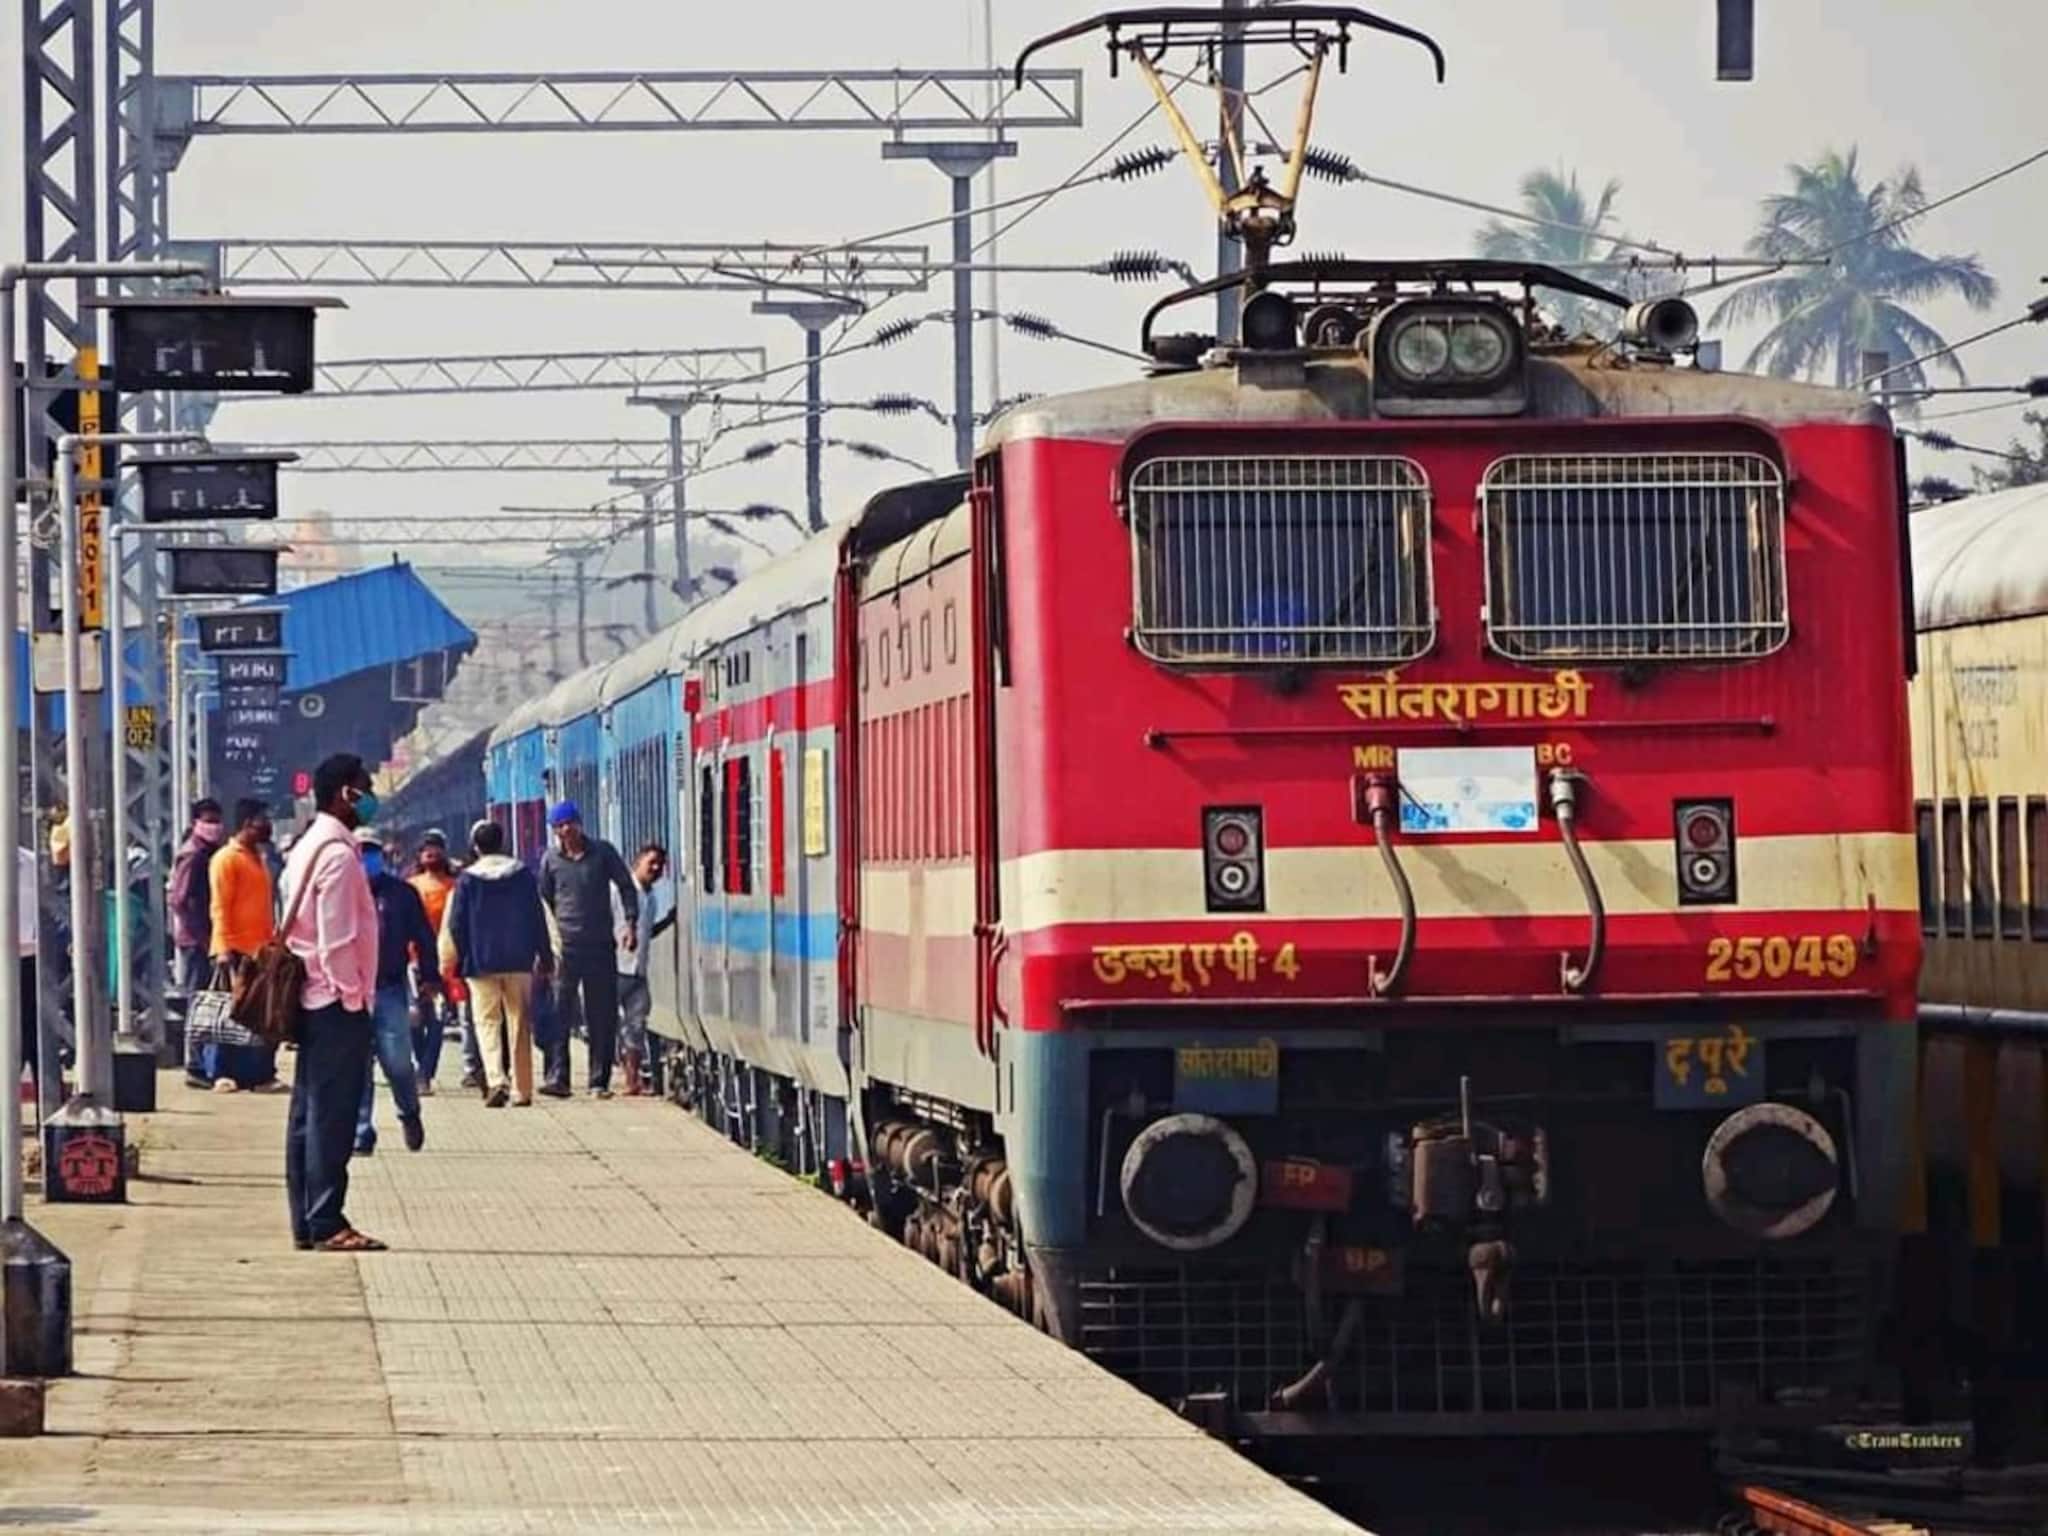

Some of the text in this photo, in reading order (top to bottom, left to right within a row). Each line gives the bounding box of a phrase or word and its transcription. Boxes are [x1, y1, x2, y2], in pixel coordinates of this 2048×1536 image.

[1354, 746, 1394, 768] MR
[1537, 744, 1572, 765] BC
[1705, 933, 1858, 982] 25049
